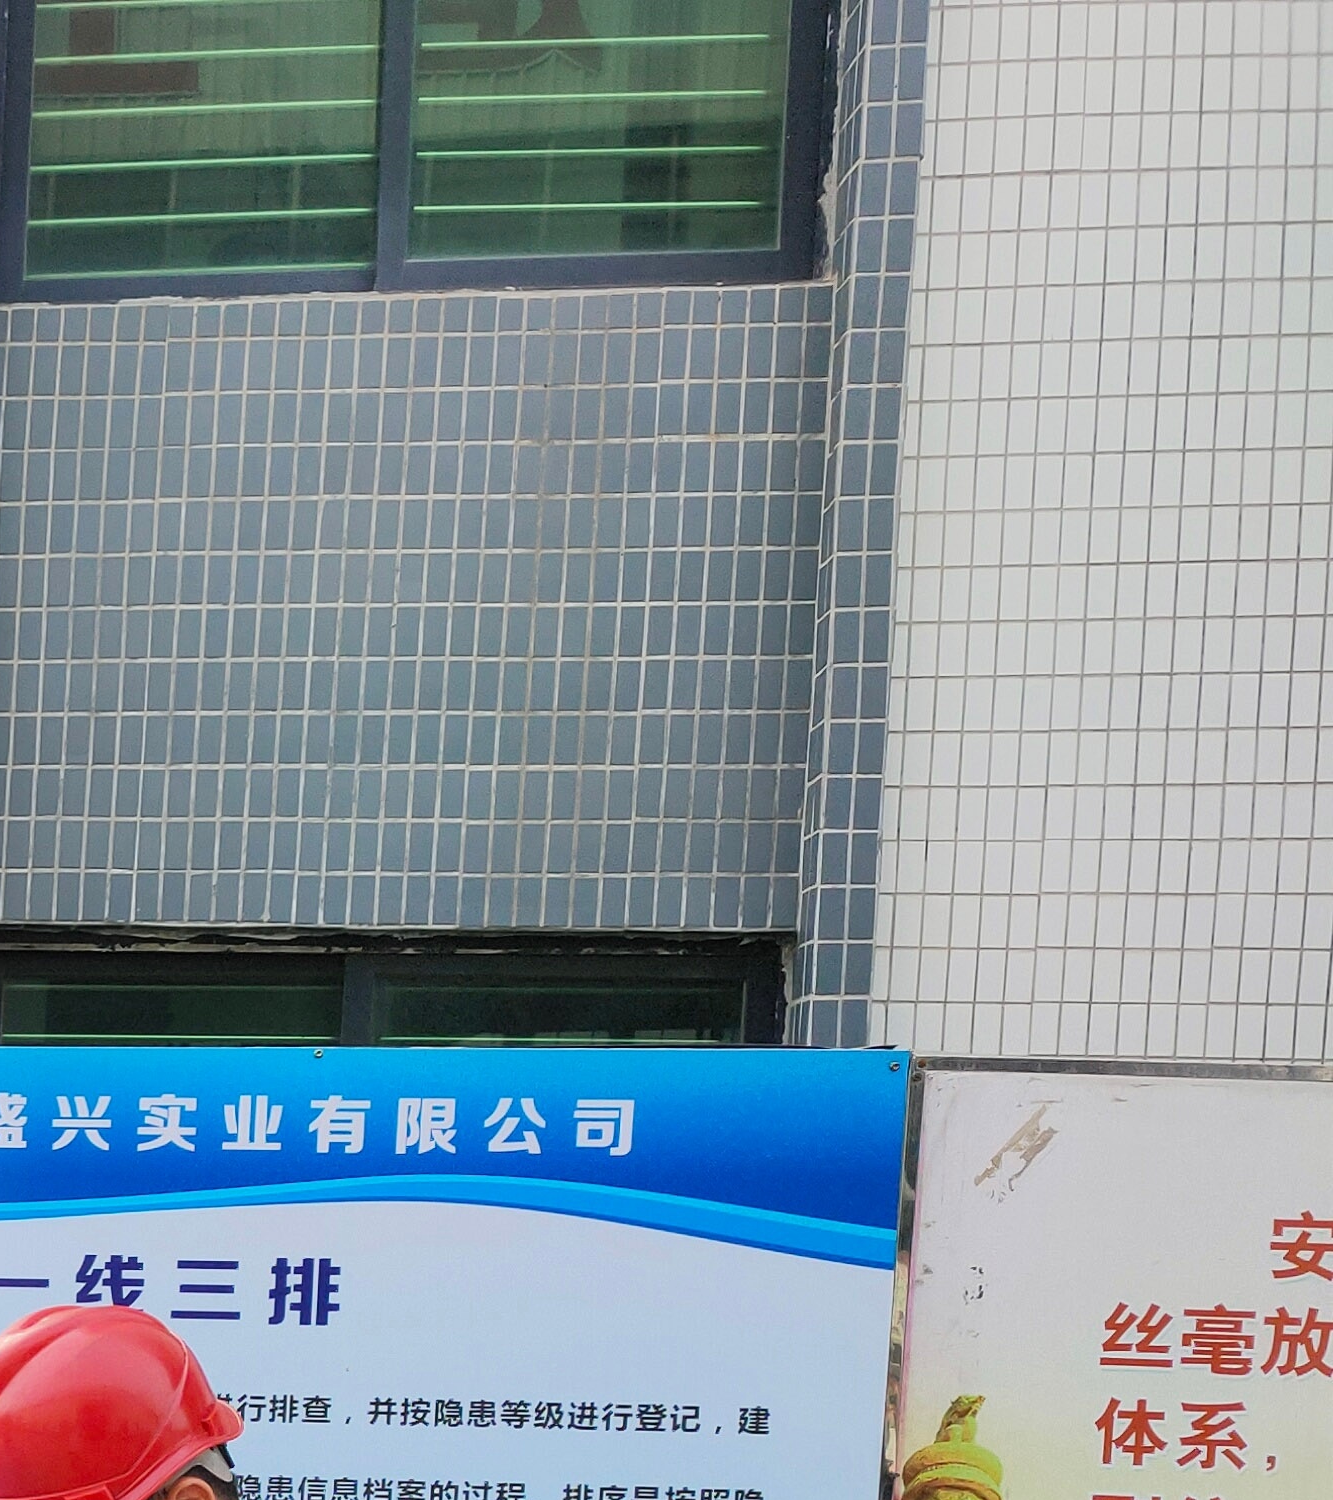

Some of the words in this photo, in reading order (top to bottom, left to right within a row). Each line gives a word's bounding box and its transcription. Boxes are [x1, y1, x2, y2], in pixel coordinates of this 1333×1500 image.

[1098, 1302, 1333, 1378] 丝毫放
[217, 1393, 771, 1436] 行排查，并按隐患等级进行登记，建
